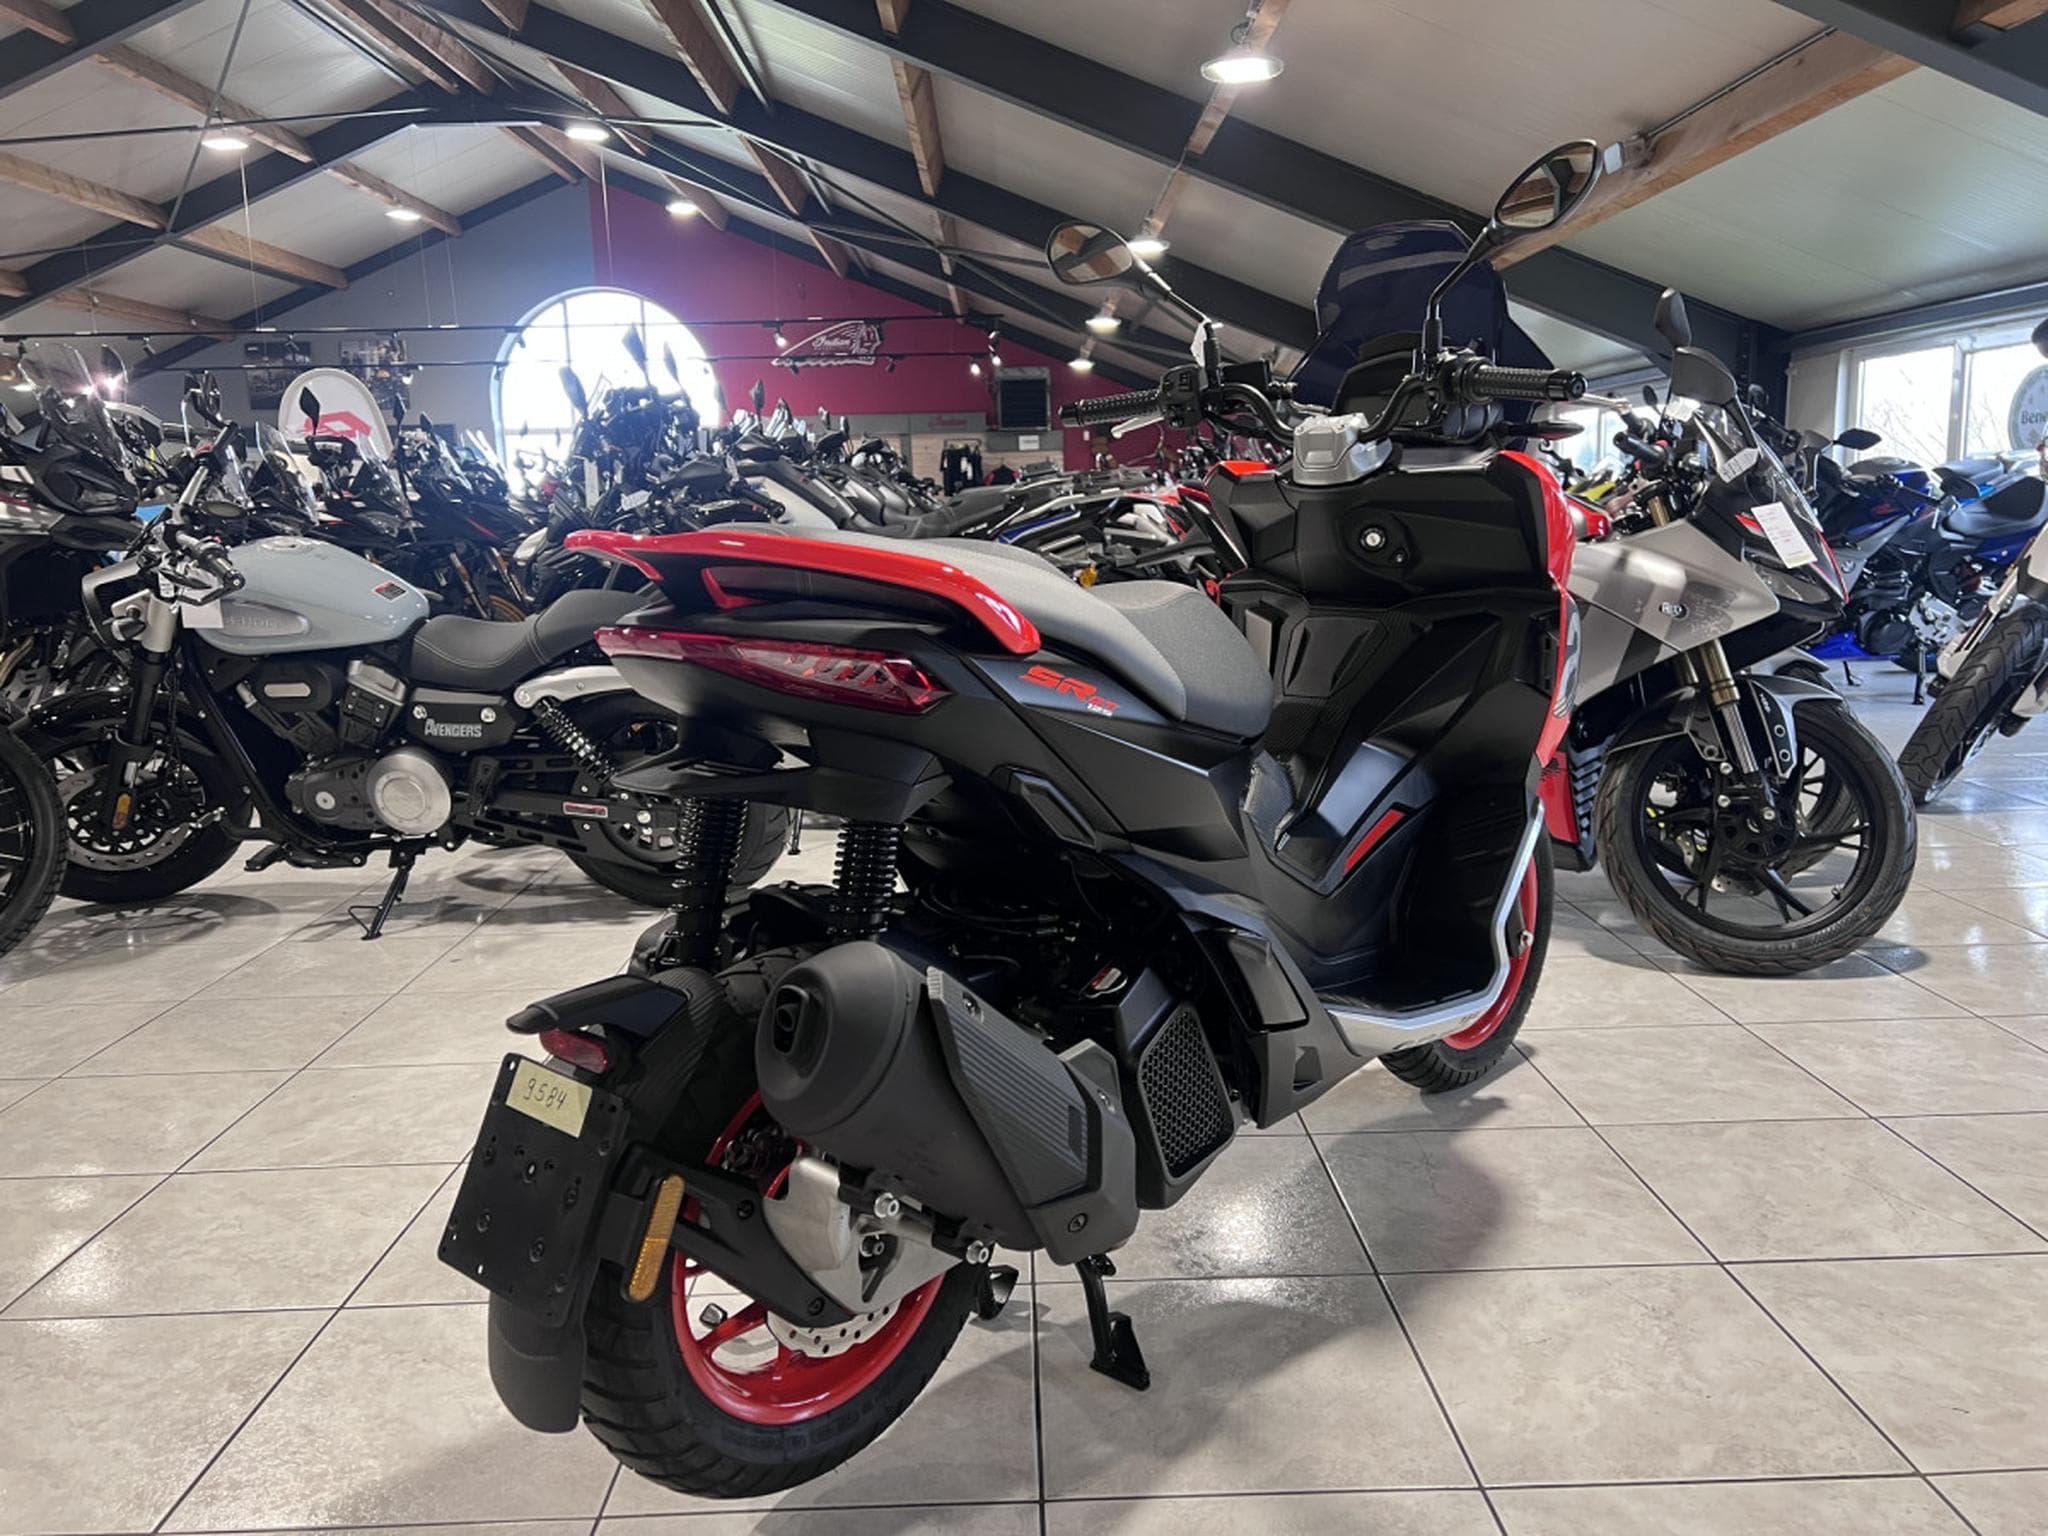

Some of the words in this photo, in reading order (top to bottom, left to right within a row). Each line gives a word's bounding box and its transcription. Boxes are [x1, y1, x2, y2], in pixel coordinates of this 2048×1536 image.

[1019, 664, 1098, 702] SR
[424, 718, 482, 738] AVENGERS
[523, 1077, 567, 1111] 9584
